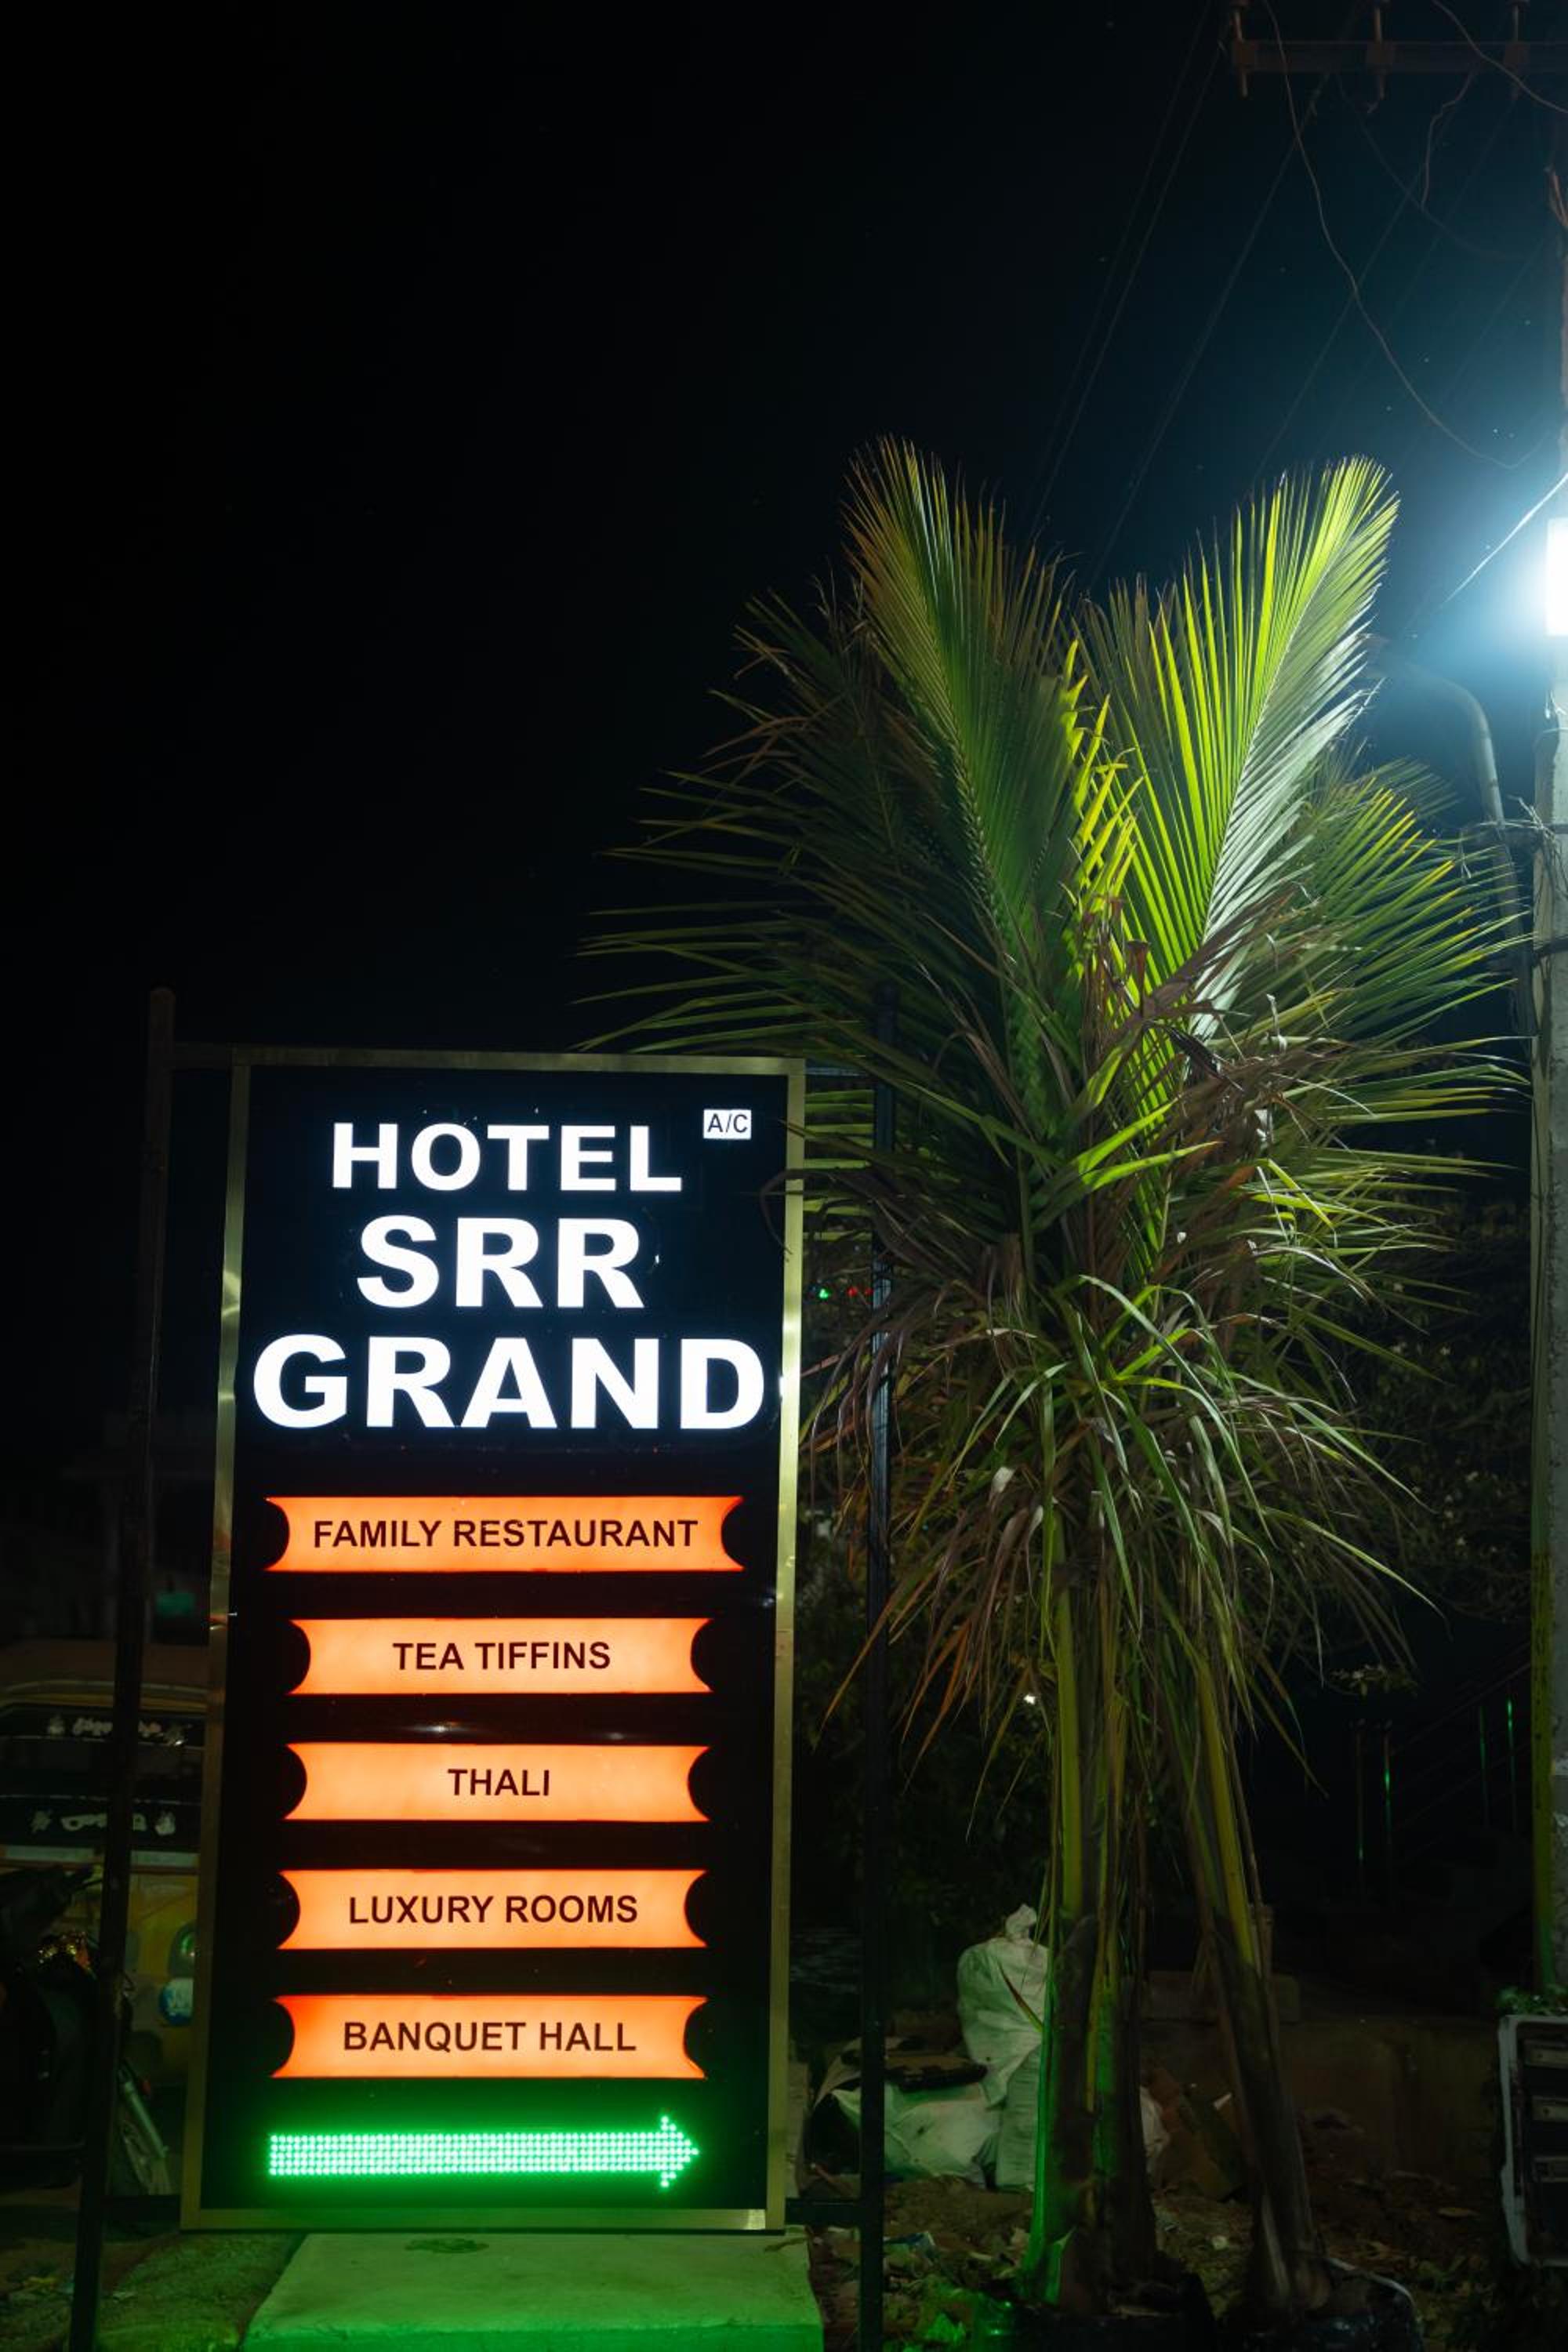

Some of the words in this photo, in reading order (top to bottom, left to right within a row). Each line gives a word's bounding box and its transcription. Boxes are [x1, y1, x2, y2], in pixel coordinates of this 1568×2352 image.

[706, 1113, 750, 1134] A/C
[332, 1123, 682, 1192] HOTEL
[357, 1214, 644, 1308] SRR
[253, 1334, 765, 1429] GRAND
[314, 1520, 441, 1548] FAMILY
[454, 1519, 699, 1547] RESTAURANT
[392, 1642, 464, 1670] TEA
[474, 1642, 611, 1670] TIFFINS
[448, 1769, 550, 1796] THALI
[350, 1896, 493, 1924] LUXURY
[506, 1895, 637, 1923] ROOMS
[344, 2022, 526, 2053] BANQUET
[540, 2022, 637, 2051] HALL
